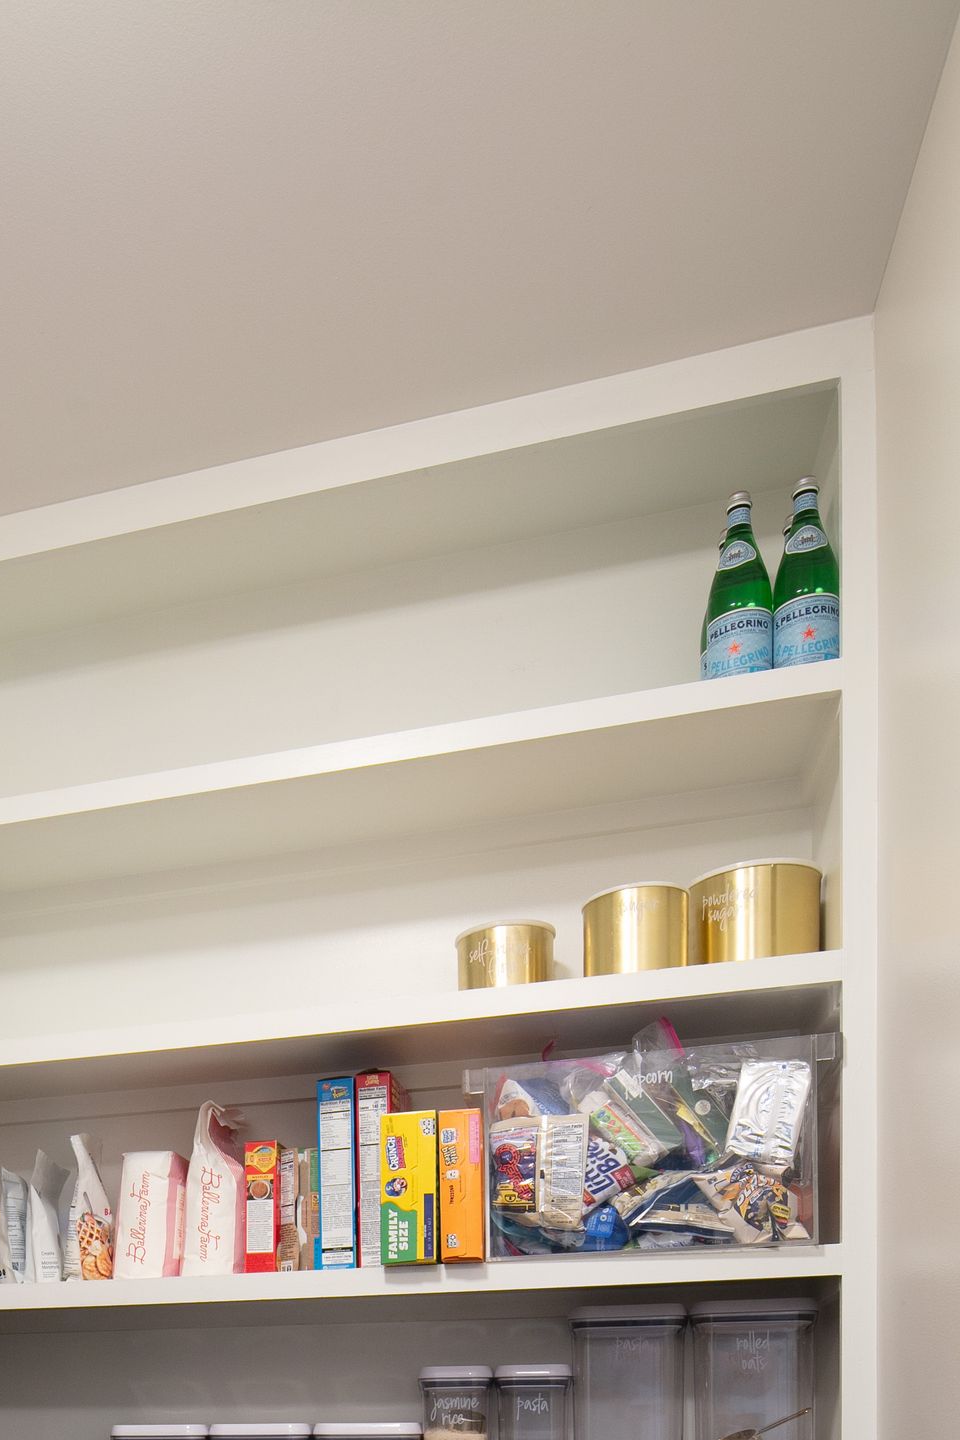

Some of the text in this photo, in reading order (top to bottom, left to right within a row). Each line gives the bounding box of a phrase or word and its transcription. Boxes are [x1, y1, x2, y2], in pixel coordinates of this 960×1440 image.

[702, 878, 756, 921] powdered
[386, 1136, 399, 1171] CRUNCH
[126, 1170, 151, 1265] Ballerina Farm
[198, 1166, 222, 1263] Ballerina Farm
[388, 1208, 399, 1259] FAMILY
[398, 1220, 409, 1251] SIZE
[736, 1330, 771, 1352] rolled
[741, 1351, 769, 1373] oats
[430, 1391, 481, 1422] jasmine
[441, 1408, 466, 1425] rice
[516, 1392, 550, 1421] pasta
